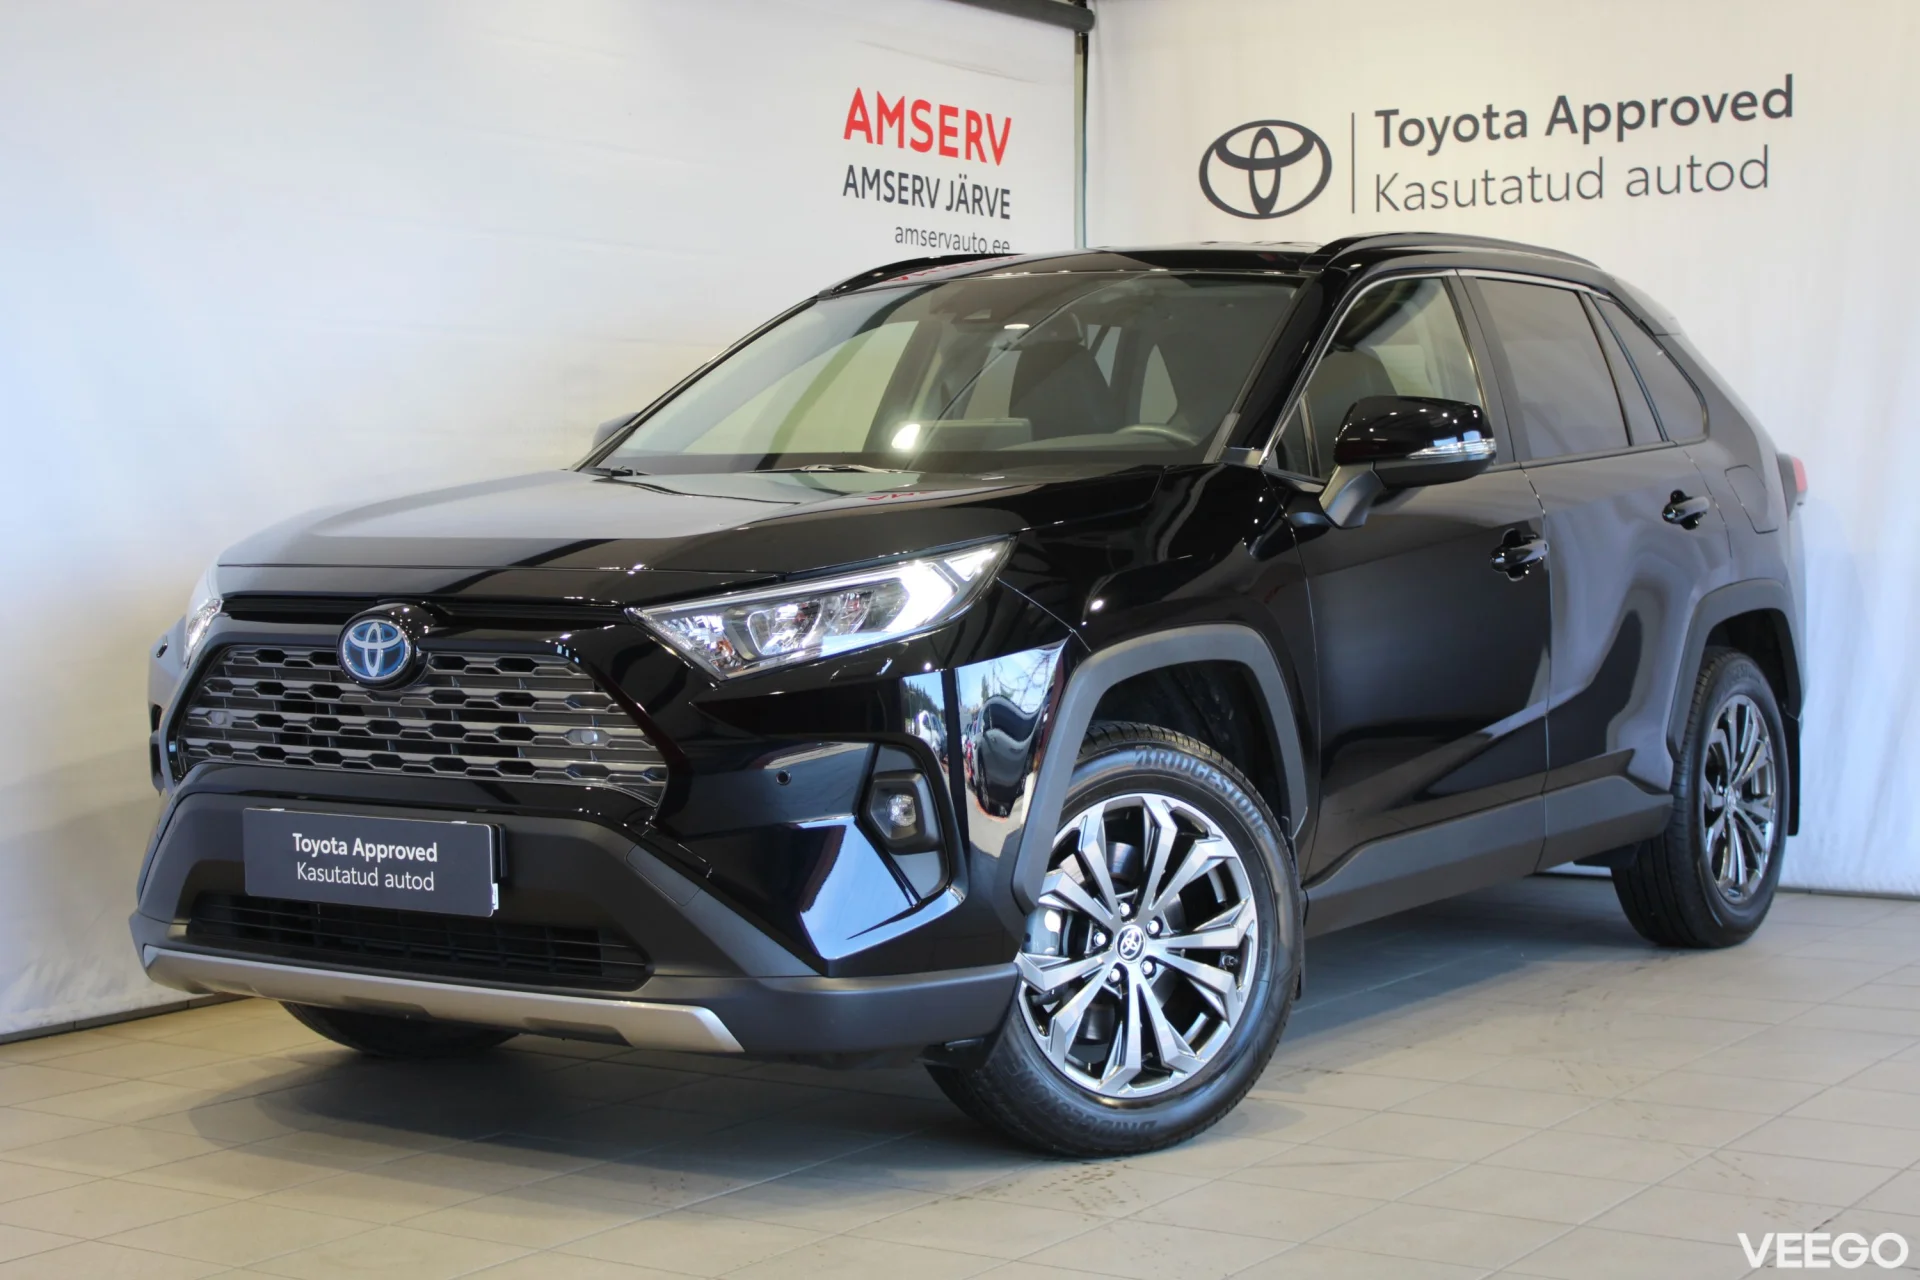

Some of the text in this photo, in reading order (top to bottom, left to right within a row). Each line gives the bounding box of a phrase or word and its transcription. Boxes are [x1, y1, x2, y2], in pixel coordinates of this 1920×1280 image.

[843, 87, 1012, 166] AMSERV
[1374, 73, 1794, 156] Toyota Approved
[842, 164, 1011, 220] AMSERV JÄRVE
[1375, 144, 1769, 213] Kasutatud autod
[894, 225, 1010, 254] amservauto.ee
[1133, 746, 1272, 839] BRIDGESTONE
[292, 832, 438, 863] Toyota Approved
[296, 861, 435, 892] Kasutatud autod
